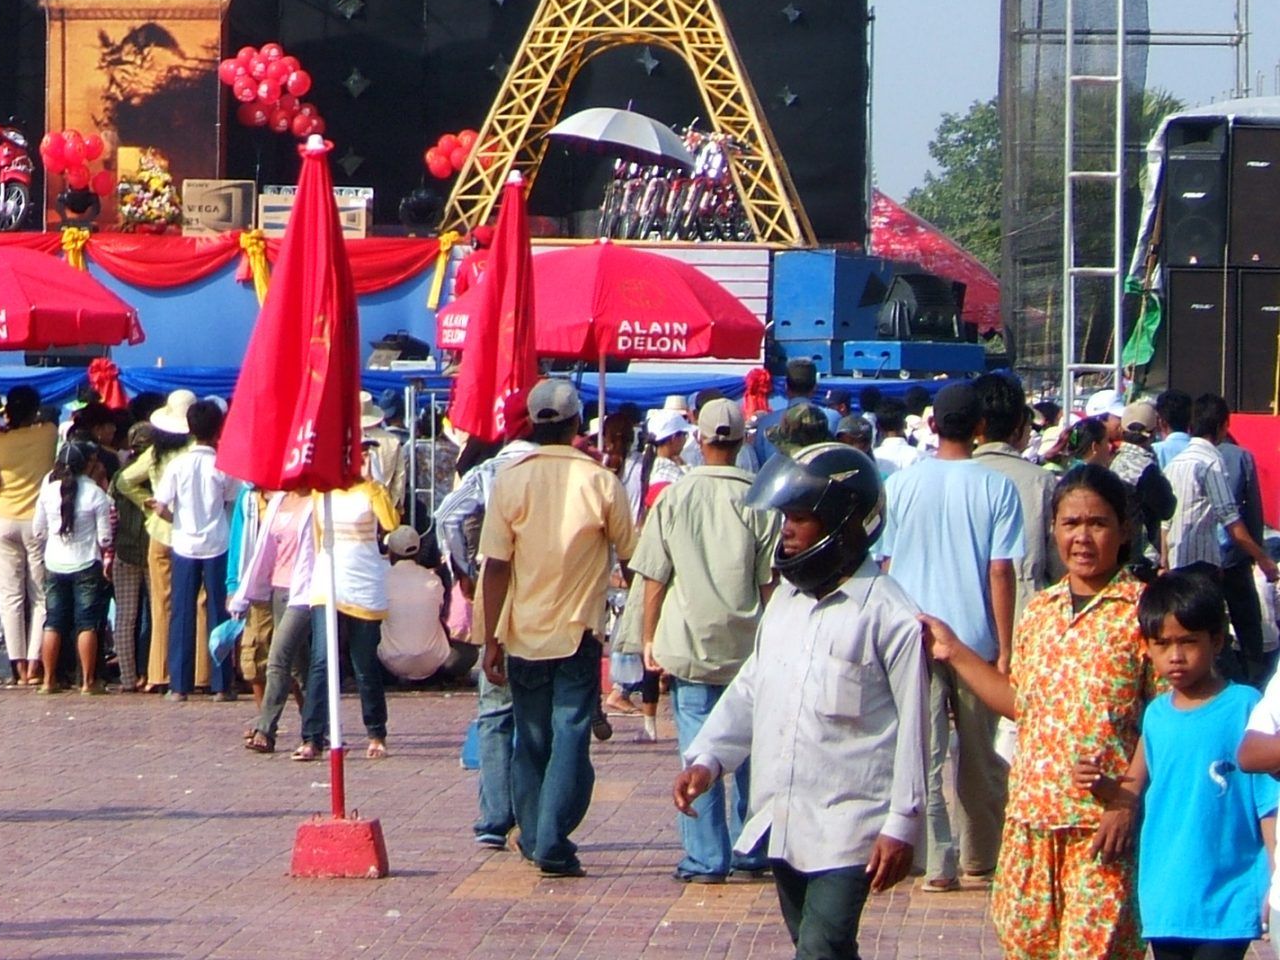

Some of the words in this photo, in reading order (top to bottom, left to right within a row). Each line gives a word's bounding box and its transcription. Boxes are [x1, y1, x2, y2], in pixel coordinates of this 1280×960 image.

[187, 204, 220, 213] WEGA
[618, 320, 688, 336] ALAIN
[617, 335, 687, 352] DELON
